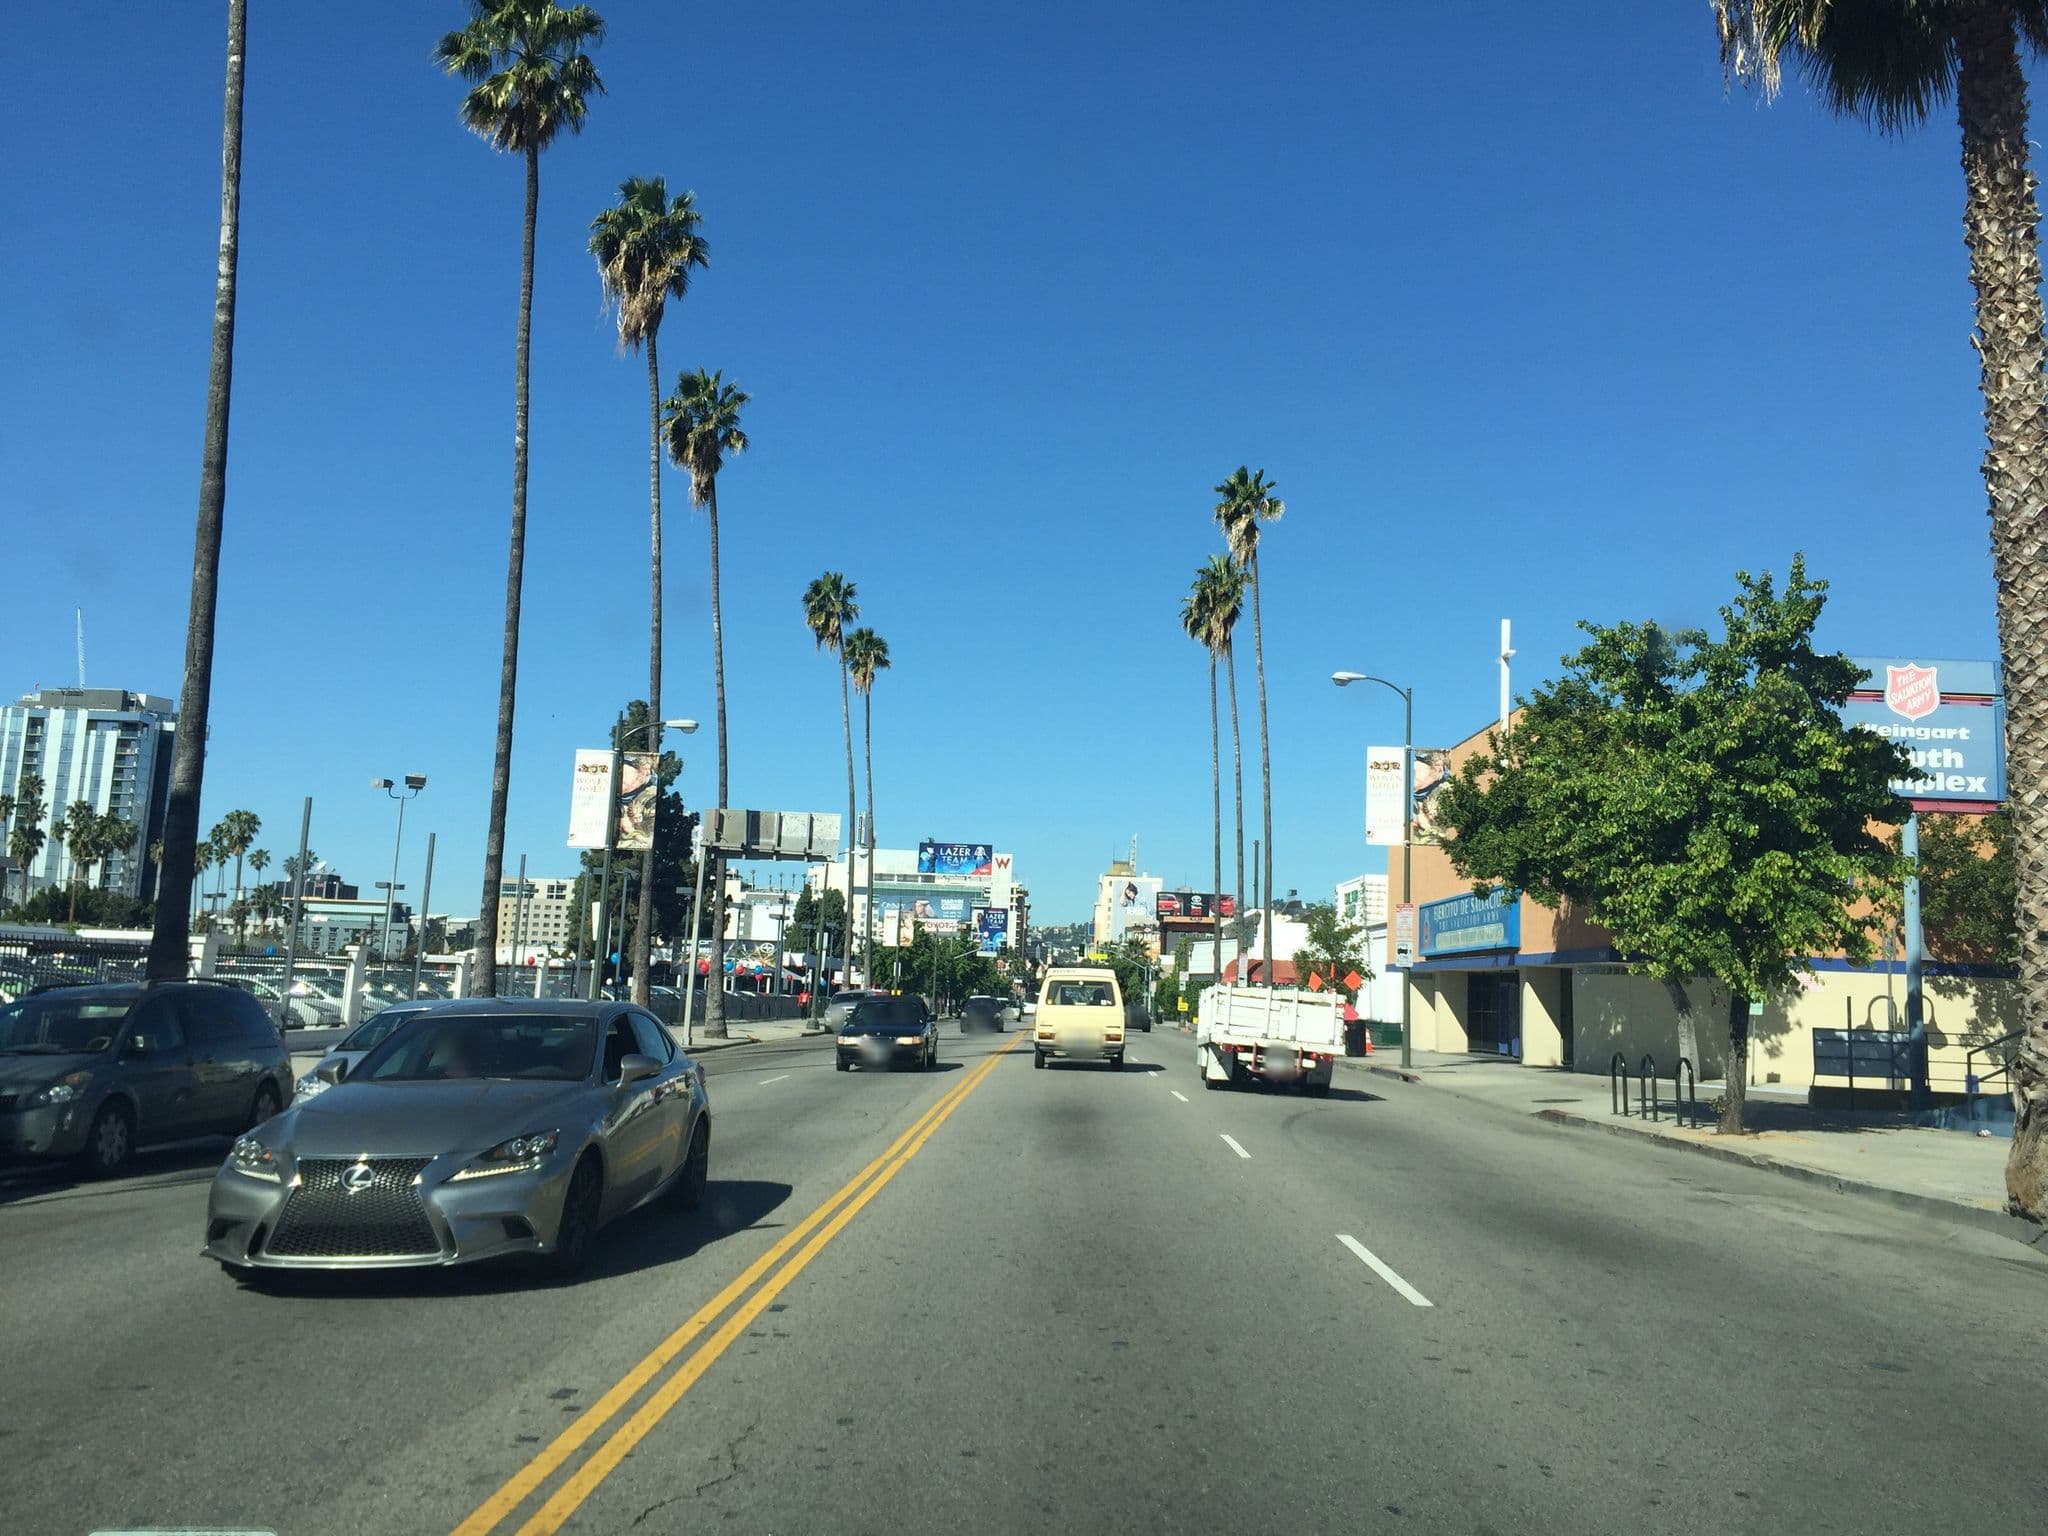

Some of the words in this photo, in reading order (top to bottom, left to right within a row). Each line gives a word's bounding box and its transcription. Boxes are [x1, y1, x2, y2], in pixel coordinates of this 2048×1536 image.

[1897, 671, 1916, 688] THE
[1890, 673, 1932, 705] SALVATION
[1906, 689, 1930, 712] ARMY
[1893, 748, 1963, 768] uth
[1888, 772, 1987, 794] mplex
[940, 847, 971, 856] LAZER
[942, 856, 968, 864] TEAM
[995, 857, 1011, 870] W
